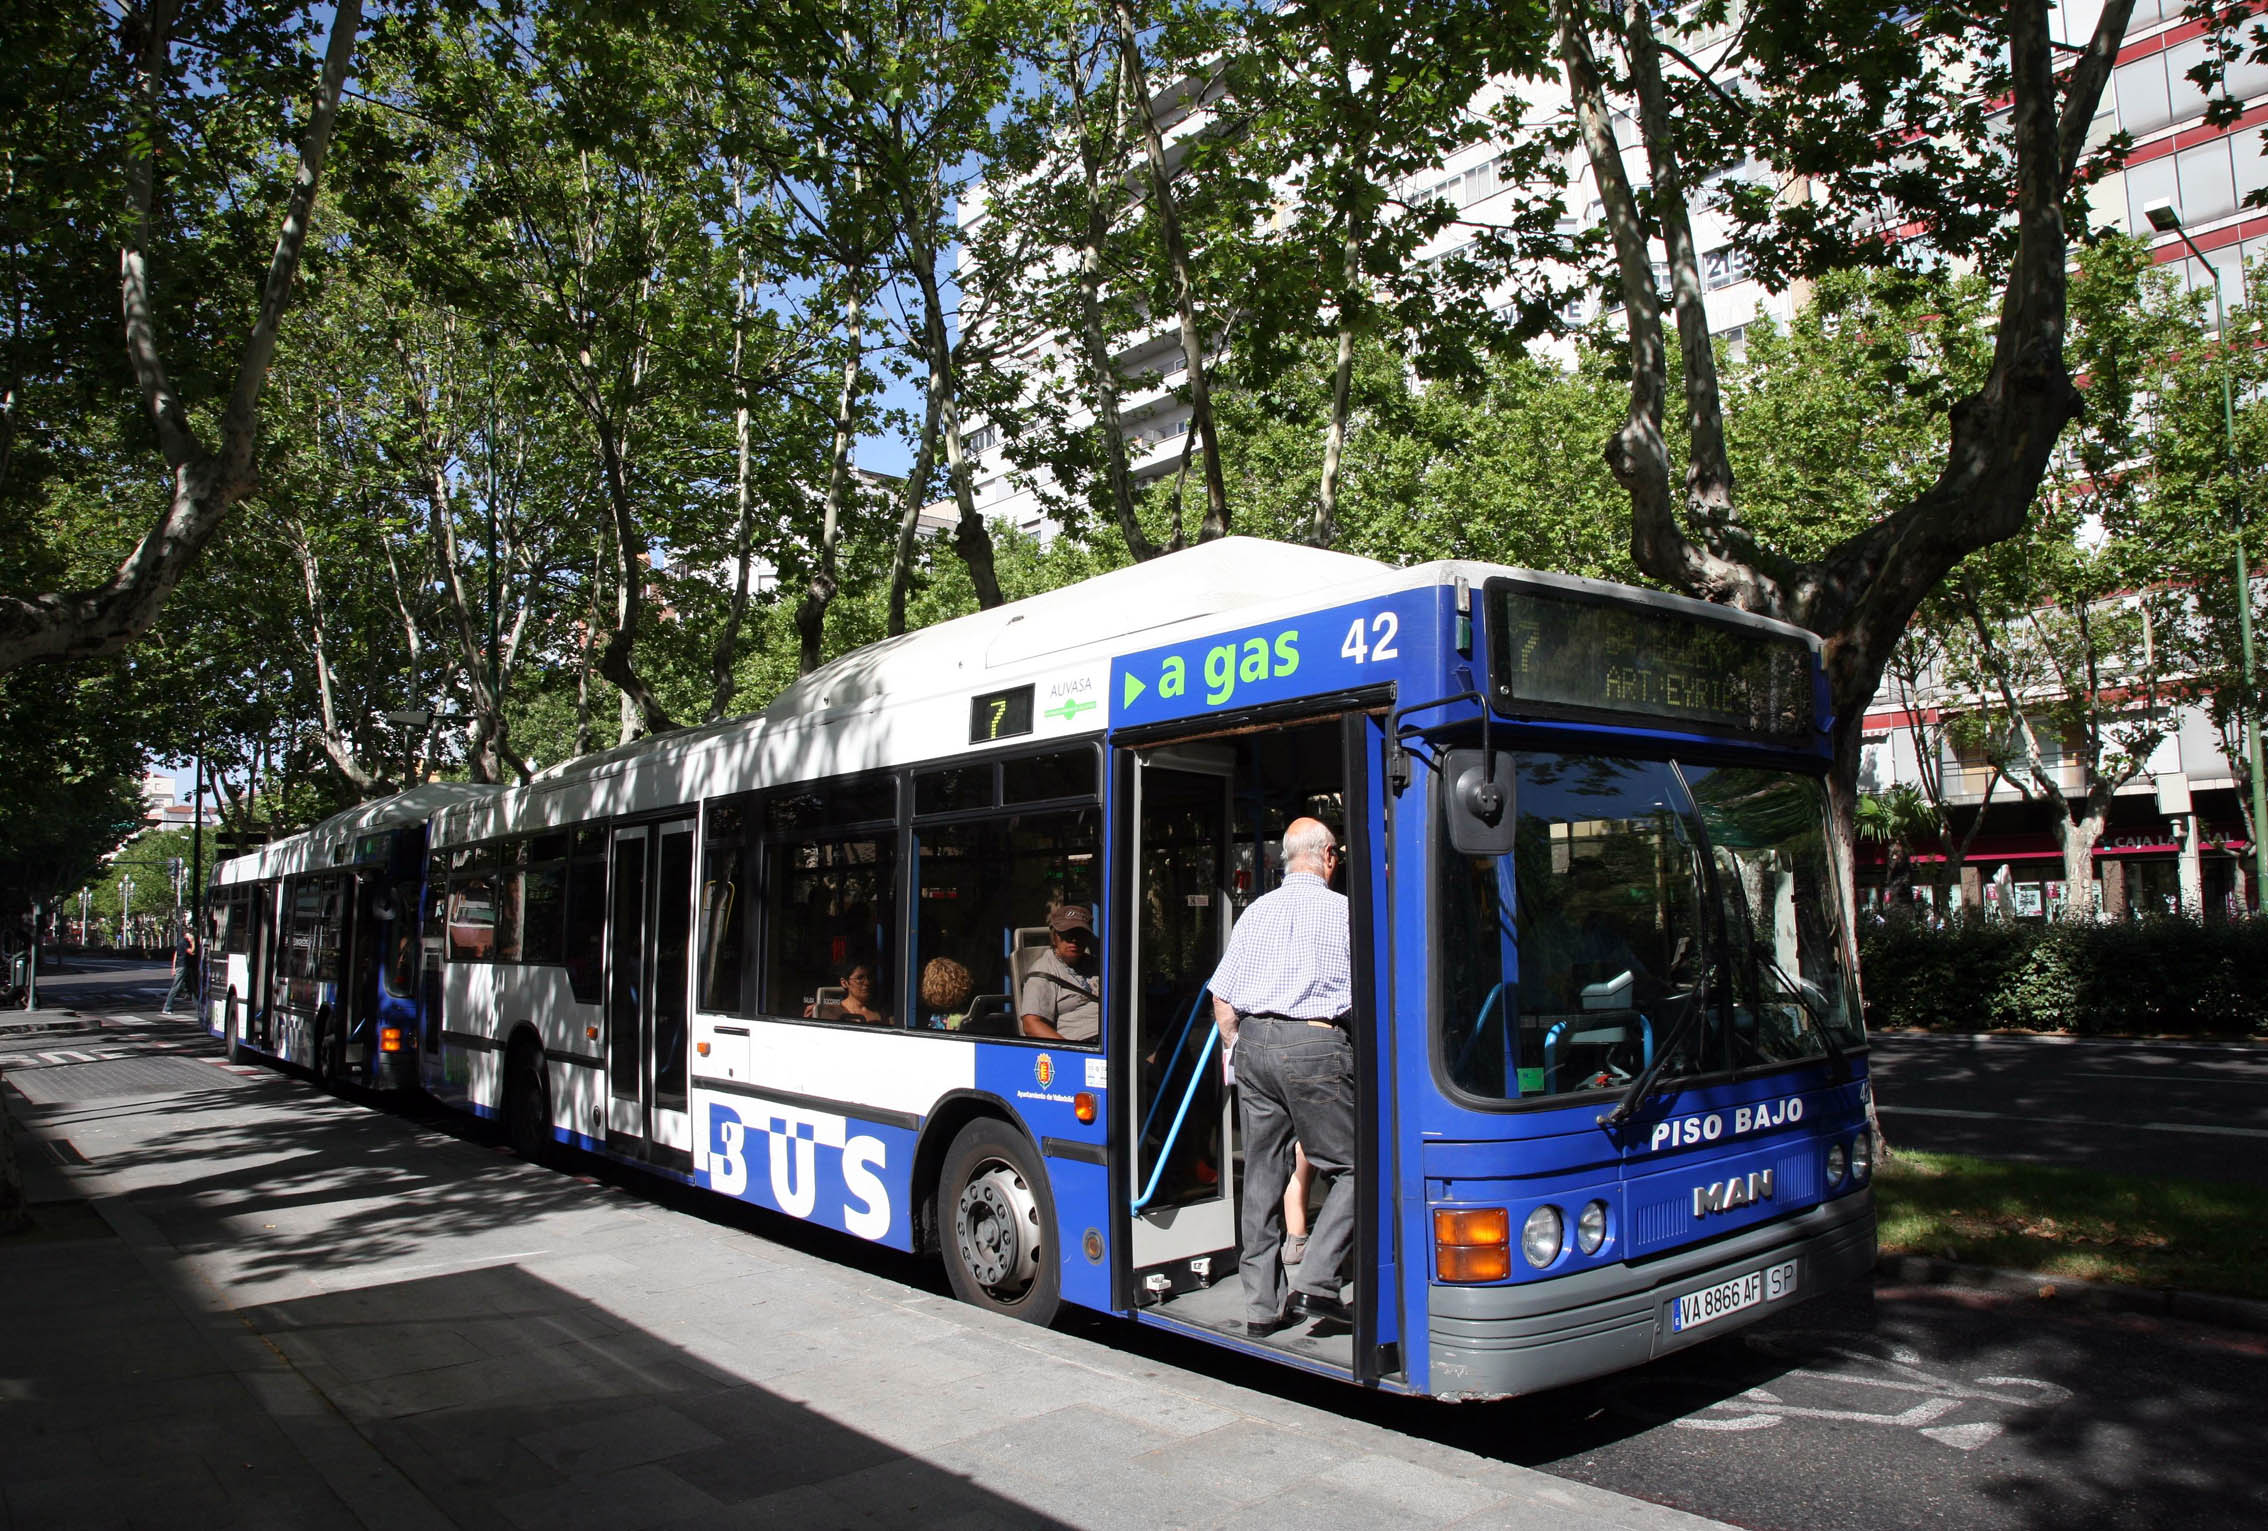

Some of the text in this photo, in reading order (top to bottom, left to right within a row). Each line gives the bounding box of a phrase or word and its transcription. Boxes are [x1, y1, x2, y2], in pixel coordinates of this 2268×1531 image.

[1341, 611, 1399, 665] 42
[1518, 621, 1540, 673] 7
[1050, 677, 1092, 698] AUVASA
[1158, 630, 1300, 706] a gas
[990, 700, 1006, 740] 7
[1652, 1098, 1804, 1151] PISO BAJO
[709, 1102, 891, 1240] BUS
[1694, 1169, 1773, 1216] MAN
[1682, 1264, 1793, 1324] VA 8866 AF SP
